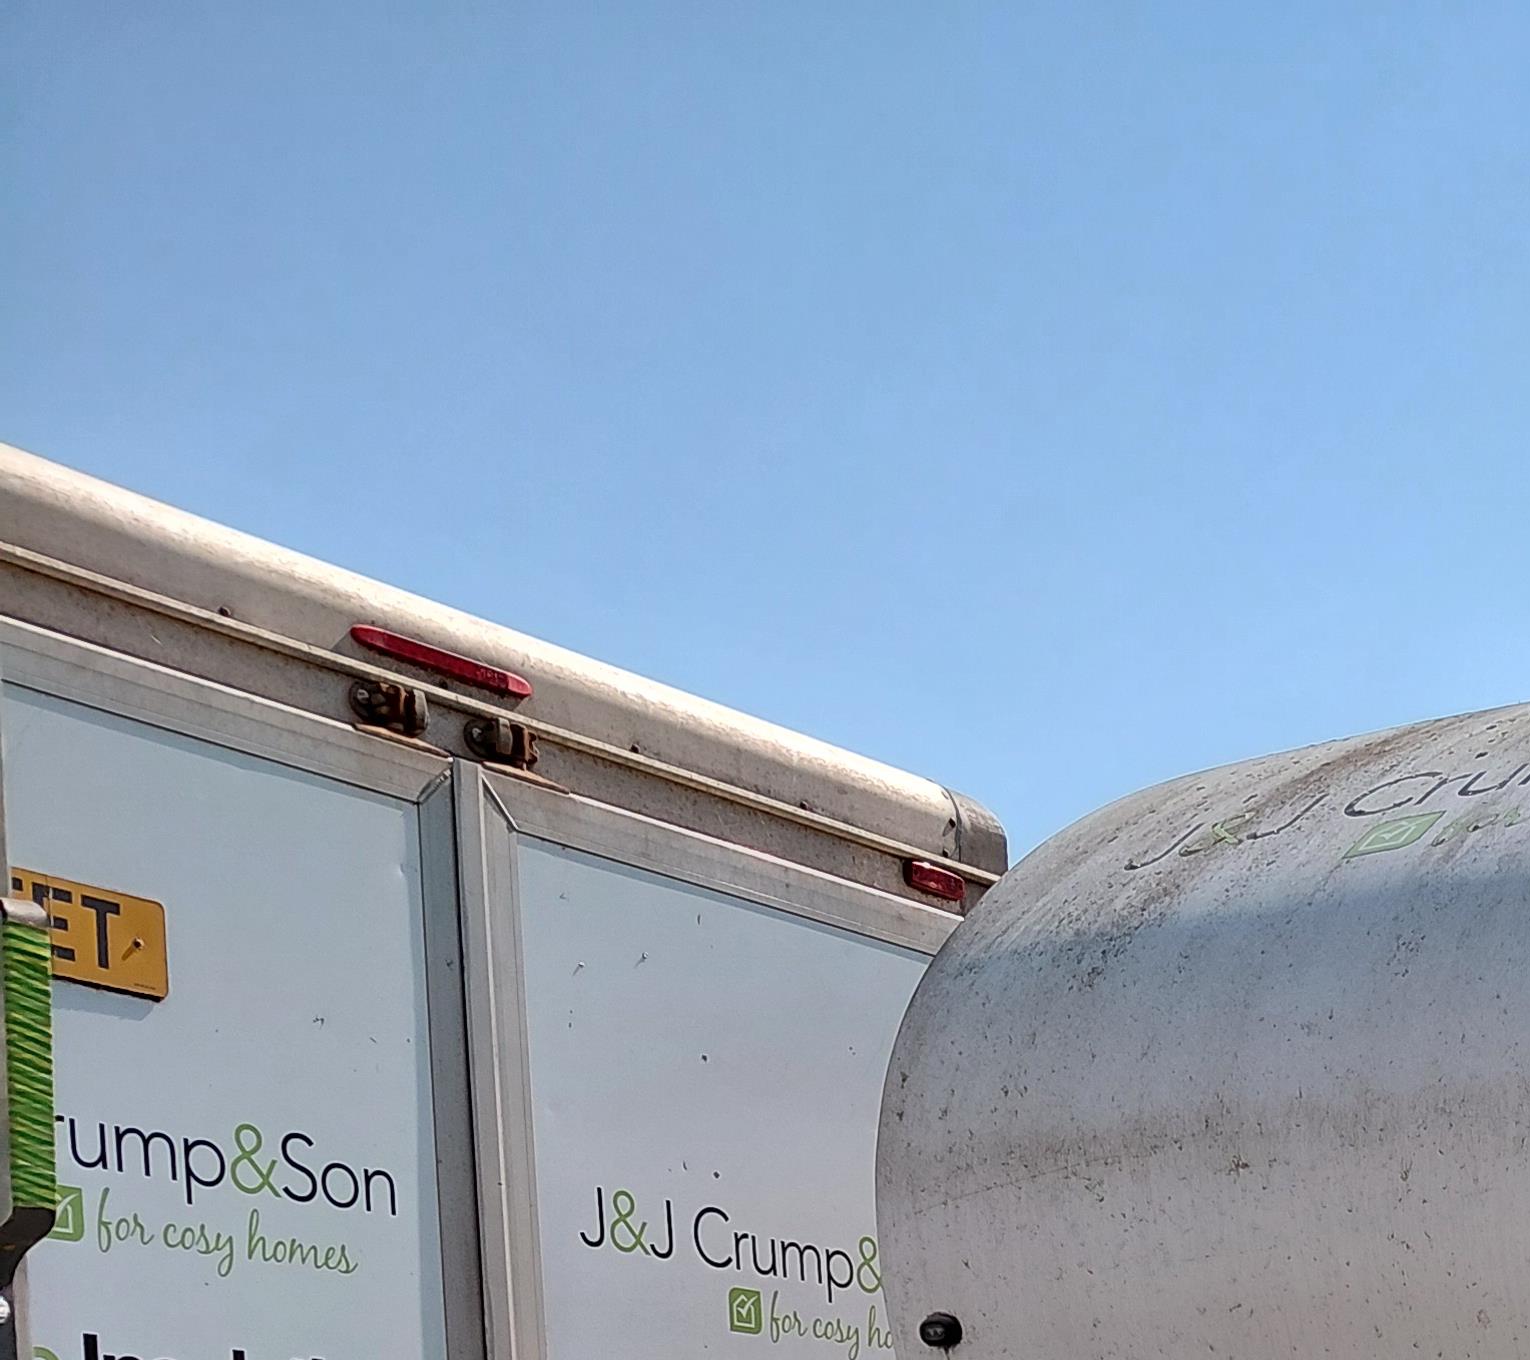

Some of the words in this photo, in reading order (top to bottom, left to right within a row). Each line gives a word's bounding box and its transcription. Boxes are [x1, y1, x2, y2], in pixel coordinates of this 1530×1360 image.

[97, 1186, 153, 1253] for
[163, 1221, 233, 1276] cosy
[247, 1207, 359, 1275] homes
[580, 1186, 675, 1261] J&J
[769, 1289, 808, 1344] for
